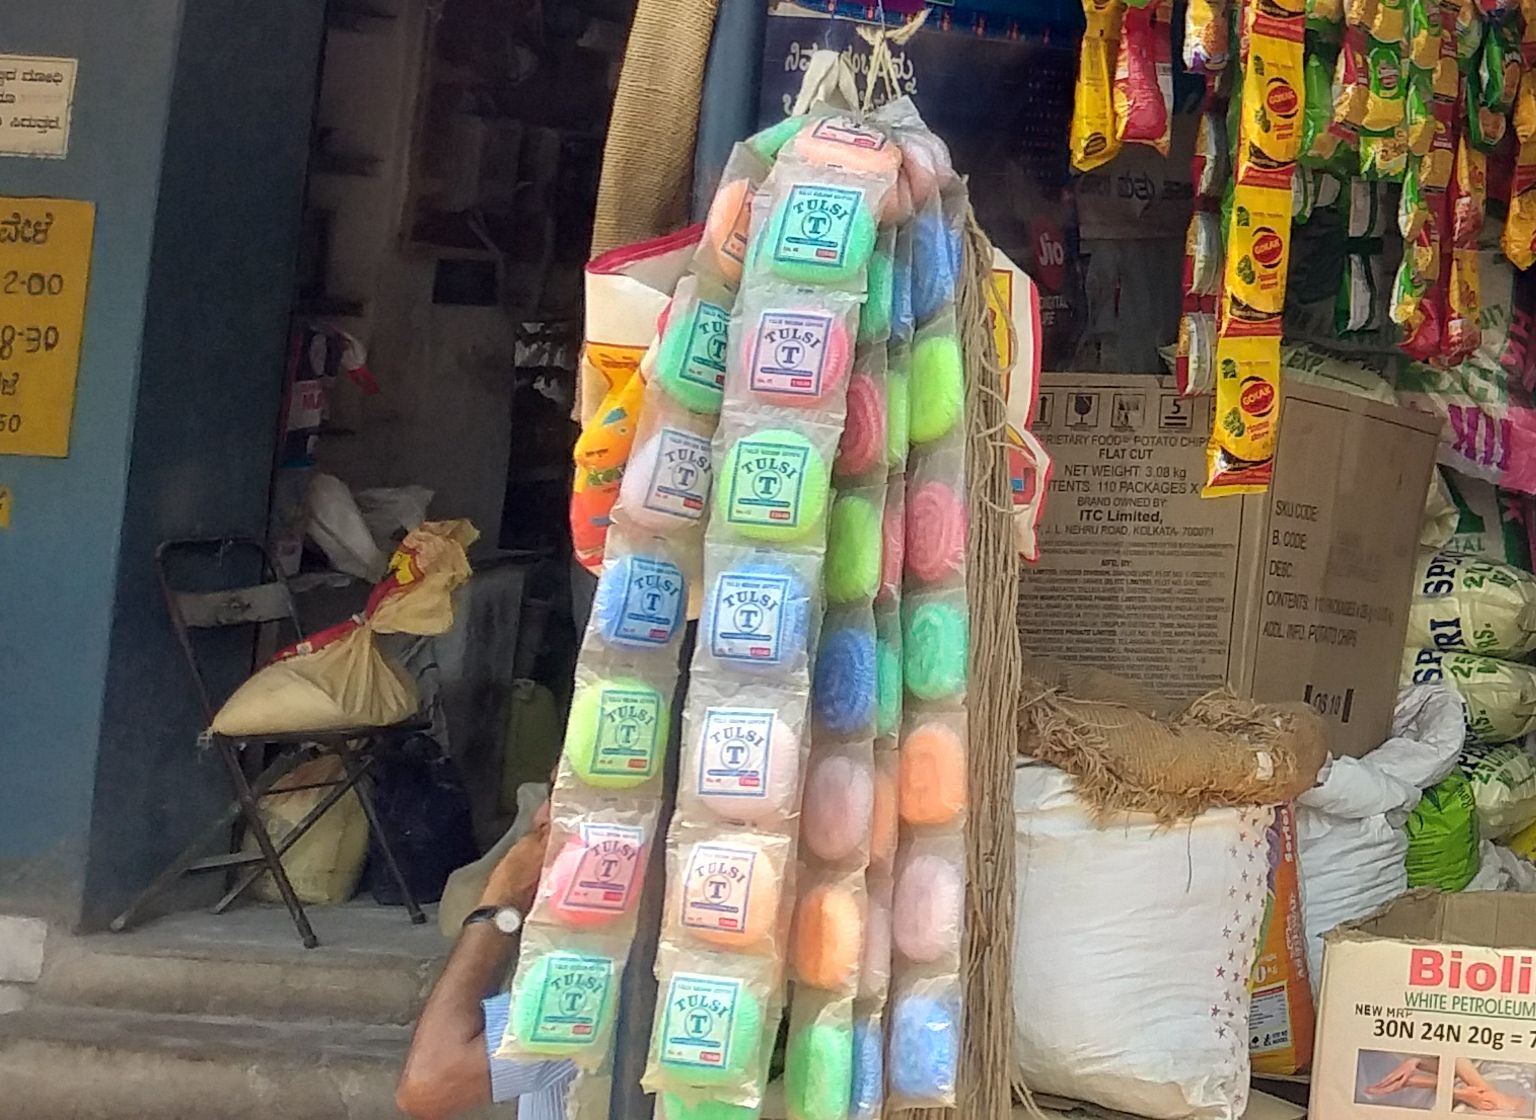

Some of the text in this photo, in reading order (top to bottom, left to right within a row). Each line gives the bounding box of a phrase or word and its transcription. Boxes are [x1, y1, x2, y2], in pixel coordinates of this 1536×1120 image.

[792, 198, 851, 221] TULSI
[807, 216, 827, 235] T
[1038, 233, 1065, 267] Jio
[765, 328, 822, 350] TULSI
[781, 346, 800, 364] T
[1098, 448, 1154, 460] FLAT CUT
[677, 466, 695, 487] T
[741, 457, 798, 480] TULSI
[1064, 464, 1187, 481] NET WEIGHT 3.08 kg
[758, 476, 778, 495] T
[1097, 481, 1118, 493] 110
[1119, 481, 1187, 495] PACKAGES
[1077, 496, 1112, 507] BRAND
[1112, 497, 1151, 508] OWNED
[1275, 499, 1295, 518] SKU
[1079, 509, 1164, 525] ITC Limited,
[1064, 525, 1099, 536] NEHRU
[634, 573, 681, 597] TULSI
[647, 592, 662, 612] T
[723, 590, 779, 612] TULSI
[739, 609, 758, 629] T
[607, 704, 656, 726] TULSI
[619, 724, 637, 744] T
[710, 726, 765, 748] TULSI
[726, 745, 745, 765] T
[591, 839, 637, 861] TULSI
[601, 858, 618, 878] T
[695, 862, 747, 884] TULSI
[707, 880, 727, 899] T
[551, 971, 604, 994] TULSI
[565, 992, 583, 1012] T
[675, 993, 729, 1018] TULSI
[1355, 1003, 1384, 1017] NEW
[1404, 991, 1536, 1018] WHITE PETROLEUM
[690, 1014, 708, 1034] T
[1373, 1018, 1415, 1040] 30N
[1420, 1022, 1462, 1043] 24N
[1467, 1025, 1504, 1050] 20g
